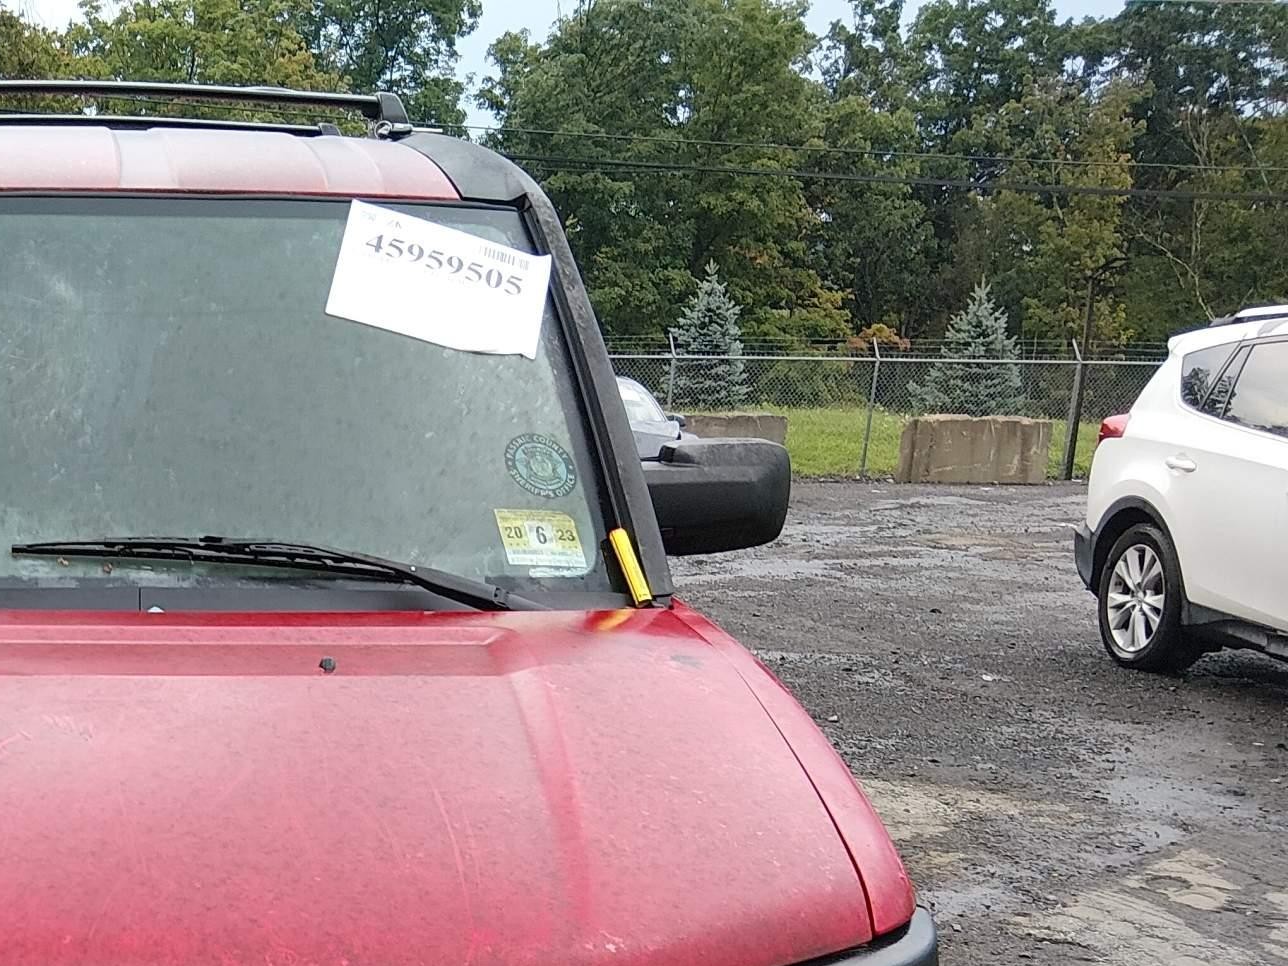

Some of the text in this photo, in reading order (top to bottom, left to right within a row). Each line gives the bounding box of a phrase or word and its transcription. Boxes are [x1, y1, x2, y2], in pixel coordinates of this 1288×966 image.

[365, 234, 524, 296] 45959505
[533, 435, 568, 459] COUNTY
[504, 525, 576, 545] 20 6 23
